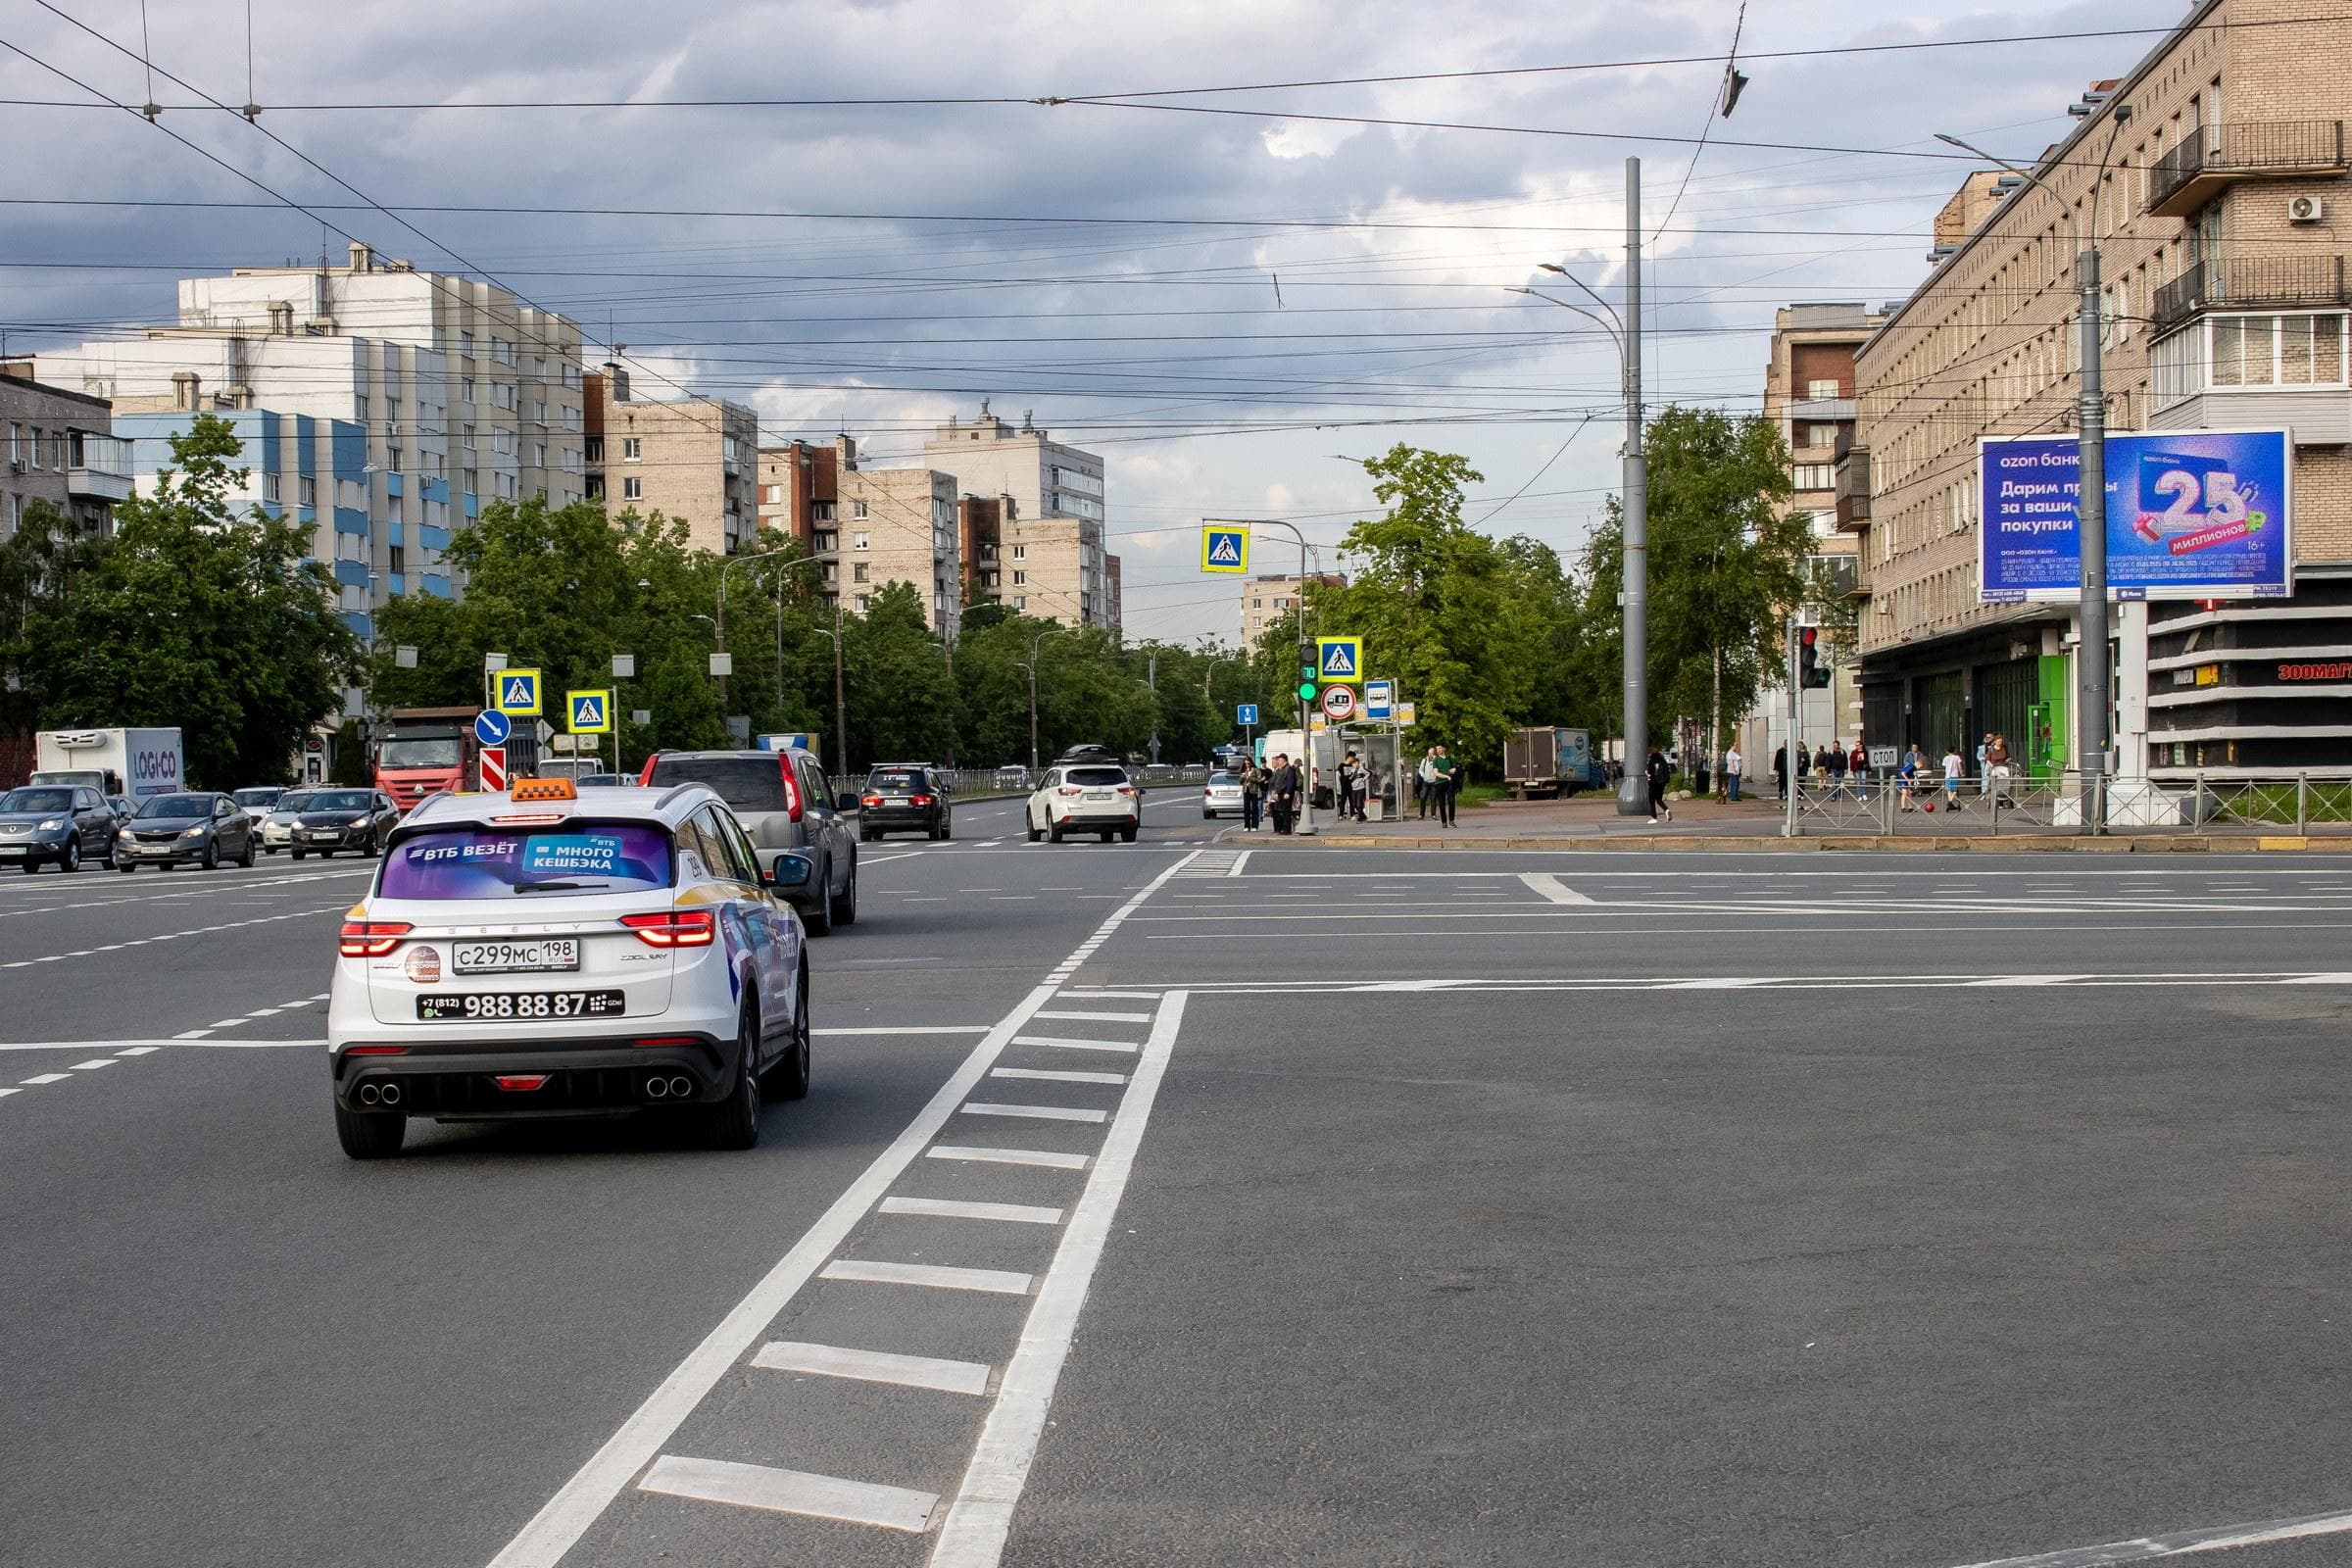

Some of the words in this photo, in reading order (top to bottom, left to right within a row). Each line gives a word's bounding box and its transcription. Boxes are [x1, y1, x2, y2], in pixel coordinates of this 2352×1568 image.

[2000, 457, 2037, 467] ozon
[2040, 452, 2081, 466] банк
[2000, 480, 2059, 498] Дарим
[2063, 481, 2118, 497] пры
[2000, 504, 2020, 514] за
[2025, 502, 2072, 514] ваши
[2154, 469, 2246, 533] 25
[2000, 519, 2074, 535] покупки
[2247, 540, 2266, 551] 16+
[2278, 662, 2352, 680] ЗООМАГ
[1873, 751, 1894, 764] СТОП
[423, 844, 459, 861] ВТБ
[463, 841, 518, 858] ВЕЗЁТ
[556, 846, 614, 858] МНОГО
[533, 858, 612, 870] КЕШБЭКА
[542, 941, 572, 956] 198
[421, 999, 434, 1007] +7
[434, 998, 460, 1008] (812)
[465, 995, 514, 1017] 988
[516, 994, 550, 1017] 88
[554, 993, 587, 1016] 87
